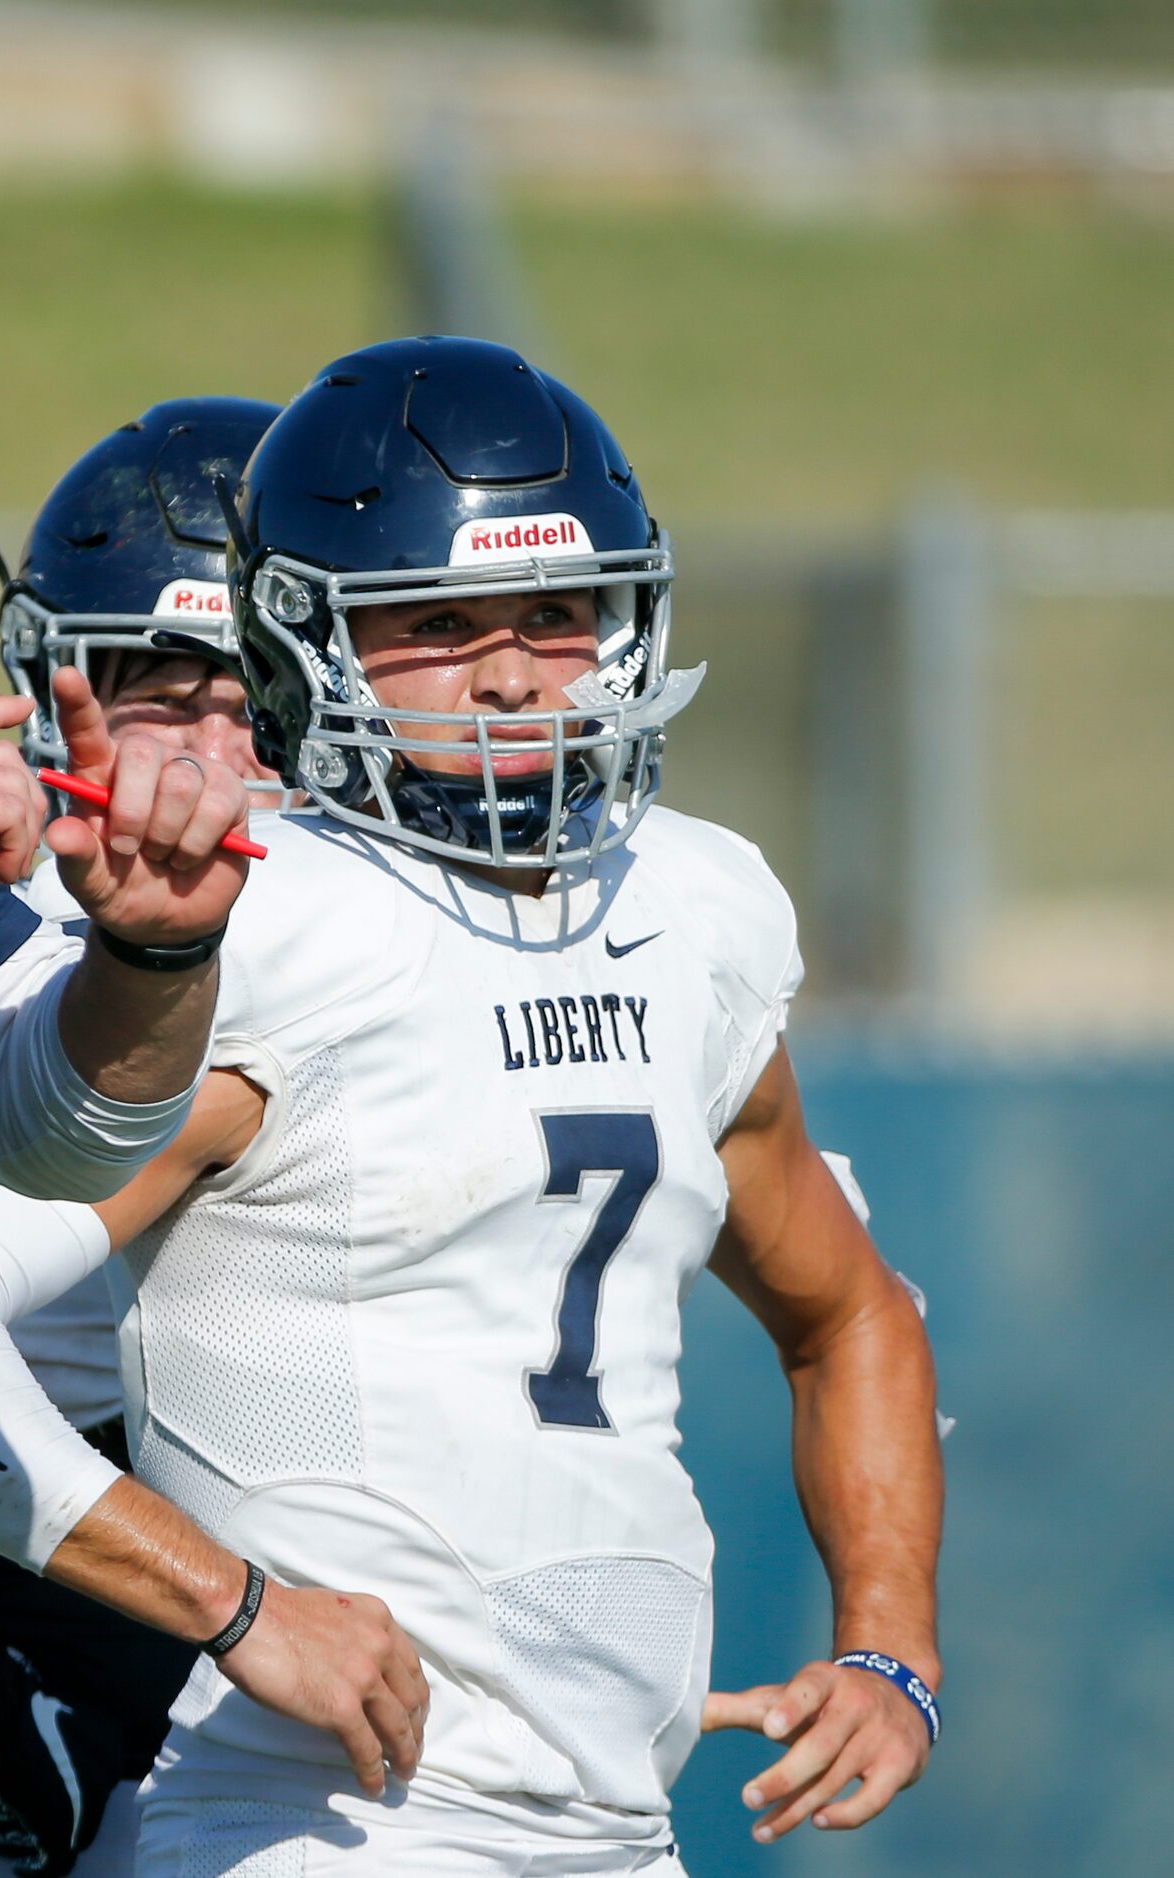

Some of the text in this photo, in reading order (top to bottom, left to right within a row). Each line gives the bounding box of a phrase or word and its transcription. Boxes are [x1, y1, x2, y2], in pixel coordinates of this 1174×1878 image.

[472, 521, 576, 551] Riddell
[478, 795, 535, 812] Rddell
[494, 993, 651, 1070] LIBERTY
[521, 1105, 664, 1437] 7
